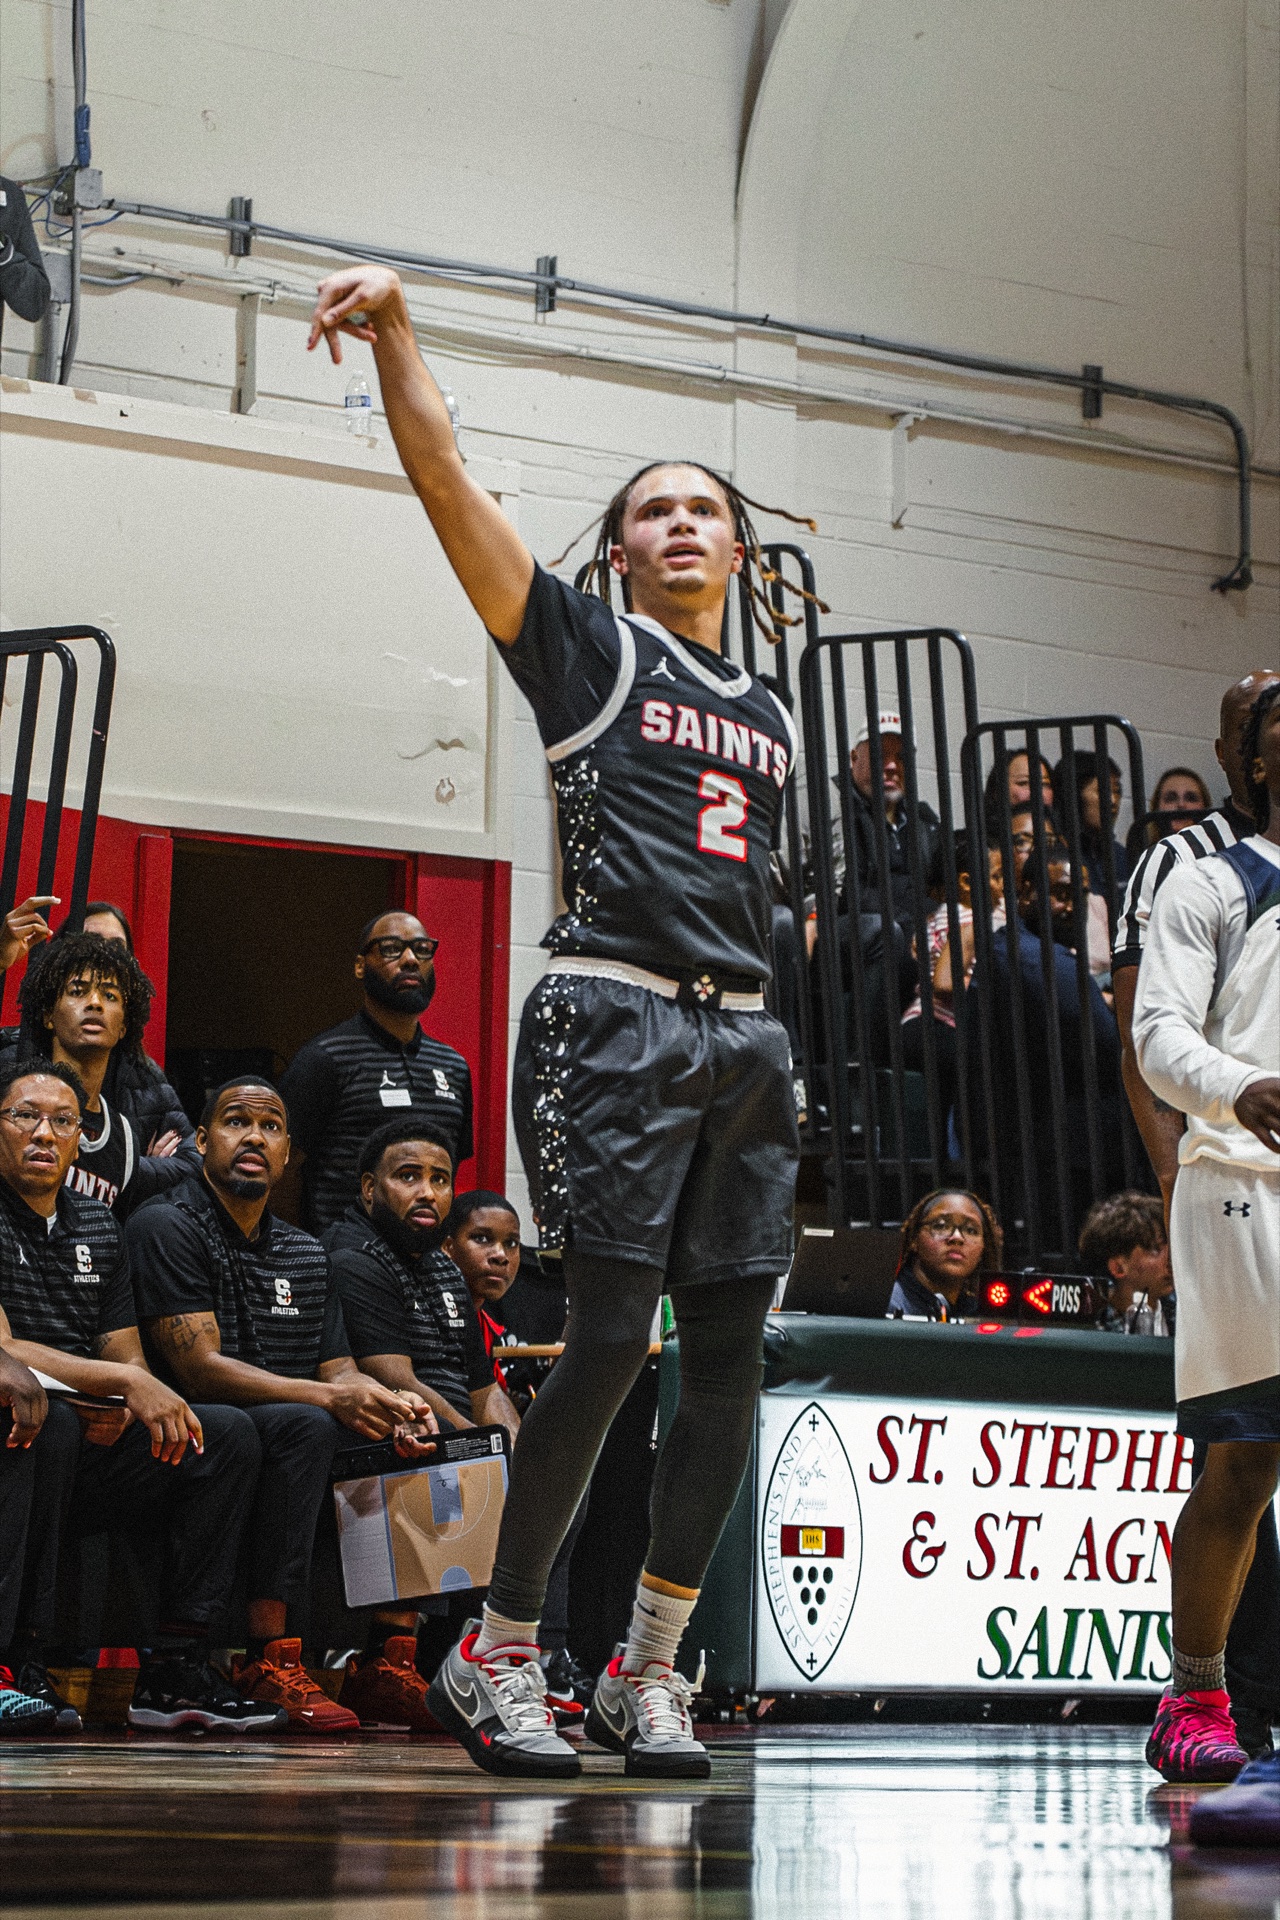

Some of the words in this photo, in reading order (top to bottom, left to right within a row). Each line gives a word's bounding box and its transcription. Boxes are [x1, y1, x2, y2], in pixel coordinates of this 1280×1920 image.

[641, 699, 788, 789] SAINTS
[697, 769, 750, 863] 2
[75, 1244, 92, 1273] S
[73, 1274, 100, 1283] ATHLETICS
[275, 1278, 292, 1306] S
[271, 1306, 299, 1316] ATHLETICS
[442, 1292, 458, 1318] S
[1052, 1284, 1081, 1314] POSS
[777, 1435, 802, 1485] AND
[869, 1413, 948, 1485] ST.
[805, 1534, 820, 1544] IHS
[902, 1511, 947, 1579] &
[967, 1511, 1043, 1581] ST.
[977, 1606, 1173, 1683] SAINTS
